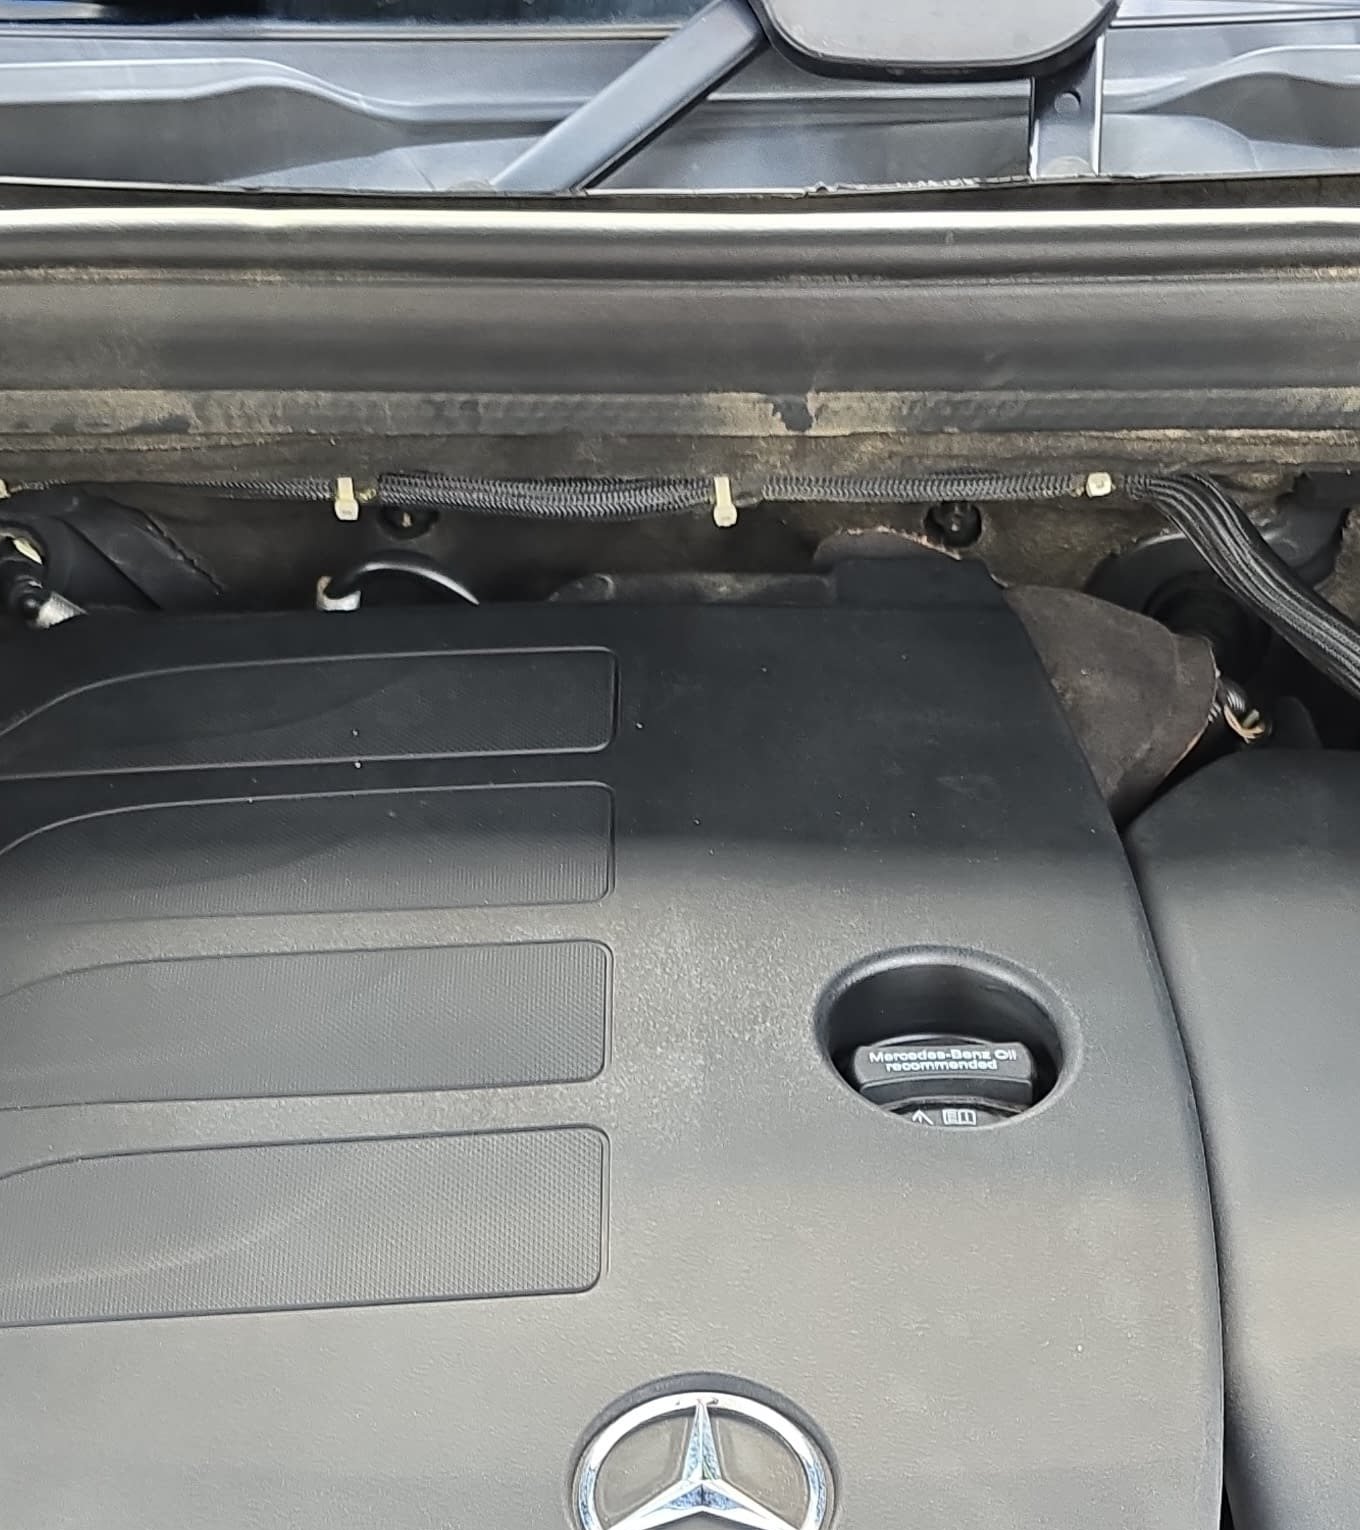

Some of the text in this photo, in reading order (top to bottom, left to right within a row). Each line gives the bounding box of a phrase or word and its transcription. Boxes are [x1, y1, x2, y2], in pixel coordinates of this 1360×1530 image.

[869, 1049, 1017, 1063] Mercedes-Benz Oil
[886, 1059, 998, 1073] recommended
